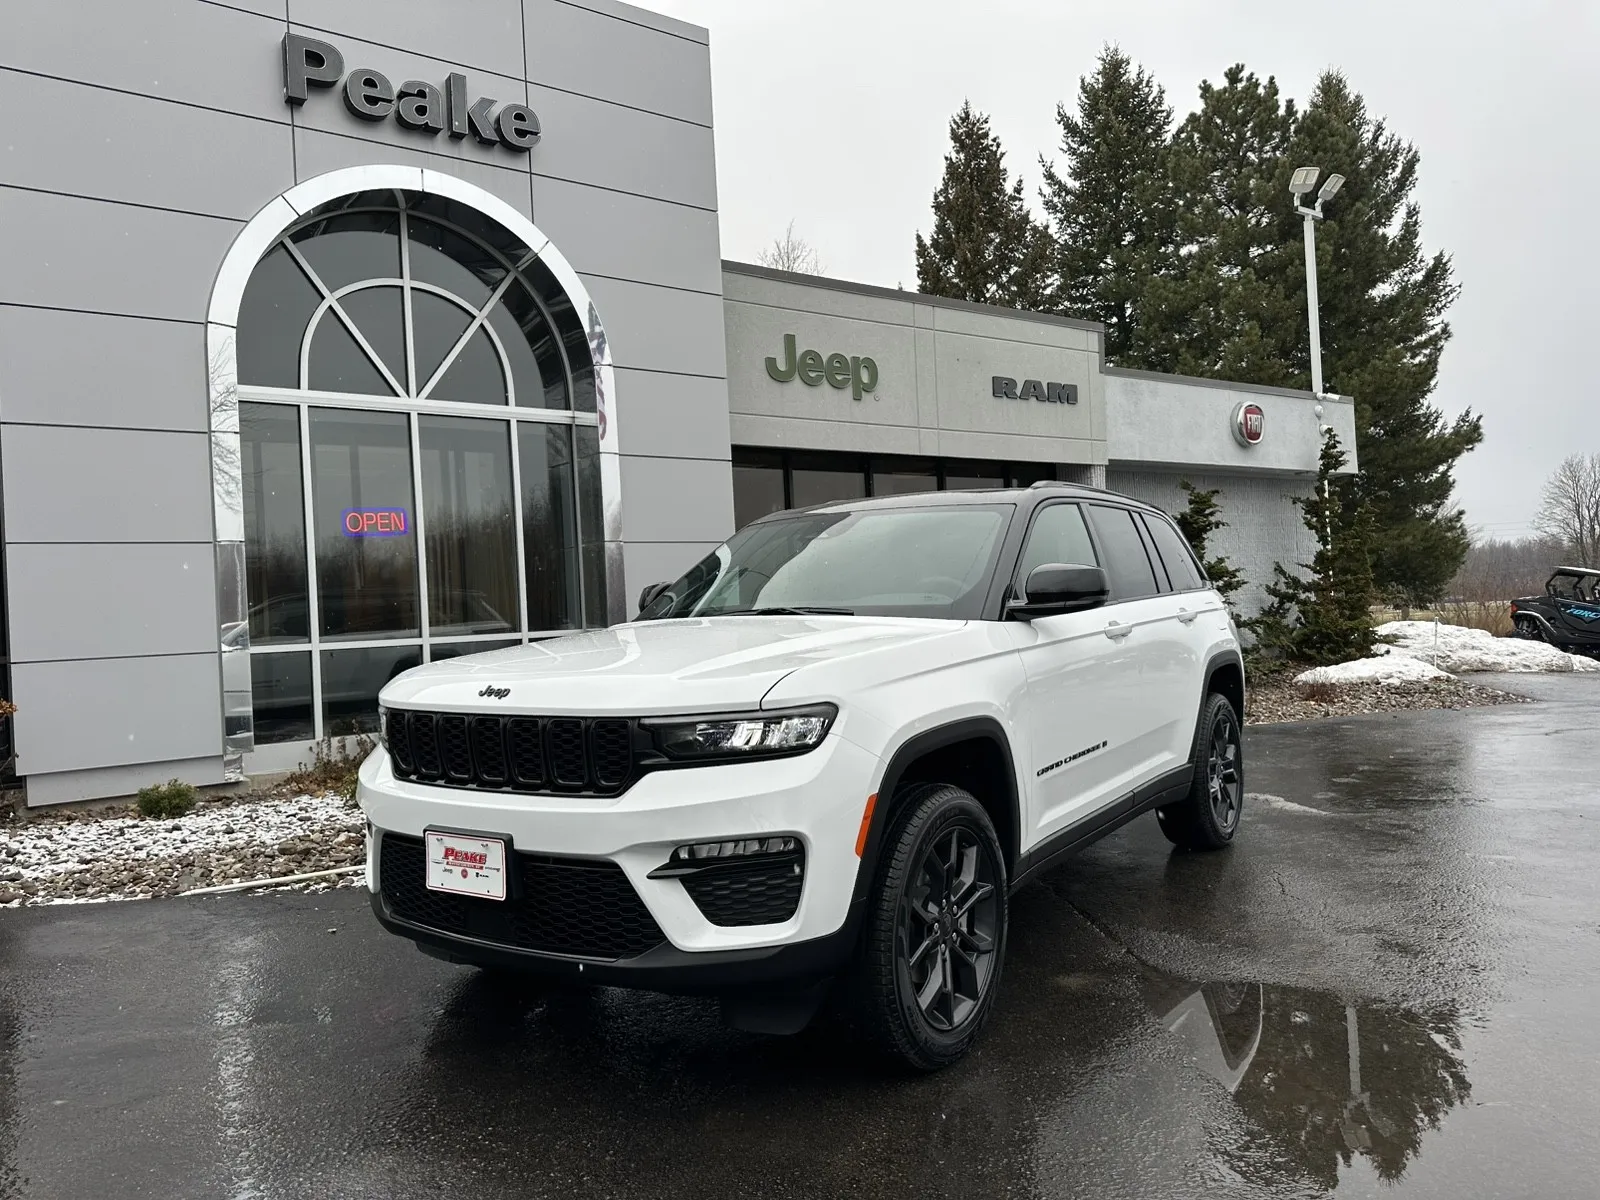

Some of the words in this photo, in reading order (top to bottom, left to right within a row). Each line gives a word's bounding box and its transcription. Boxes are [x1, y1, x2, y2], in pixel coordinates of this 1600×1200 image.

[281, 32, 541, 151] Peake
[765, 333, 879, 400] Jeep
[992, 376, 1079, 404] RAM
[346, 512, 404, 532] OPEN
[478, 684, 511, 700] Jeep
[1036, 760, 1063, 776] GRAND
[1064, 743, 1101, 763] CHEROKEE
